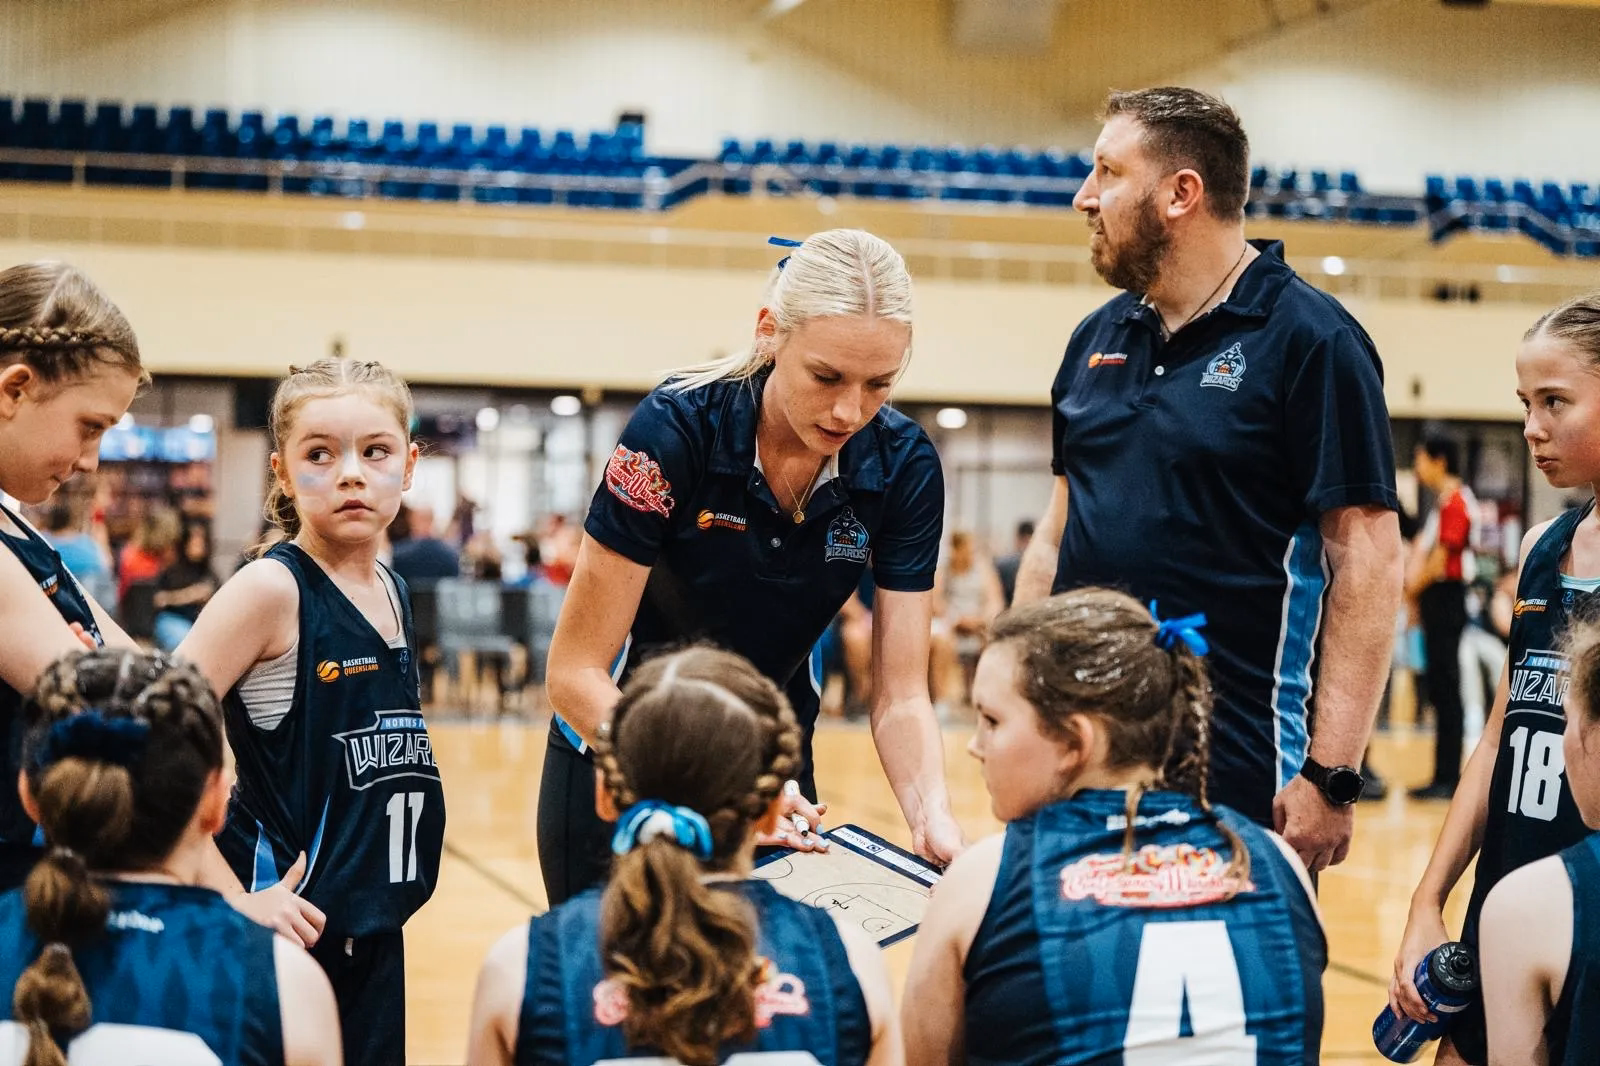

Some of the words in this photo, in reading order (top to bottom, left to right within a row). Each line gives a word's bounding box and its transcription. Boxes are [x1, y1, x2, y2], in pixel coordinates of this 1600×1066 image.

[342, 656, 377, 668] BASKETBALL
[344, 663, 379, 677] QUEENSLAND
[1507, 725, 1566, 822] 18
